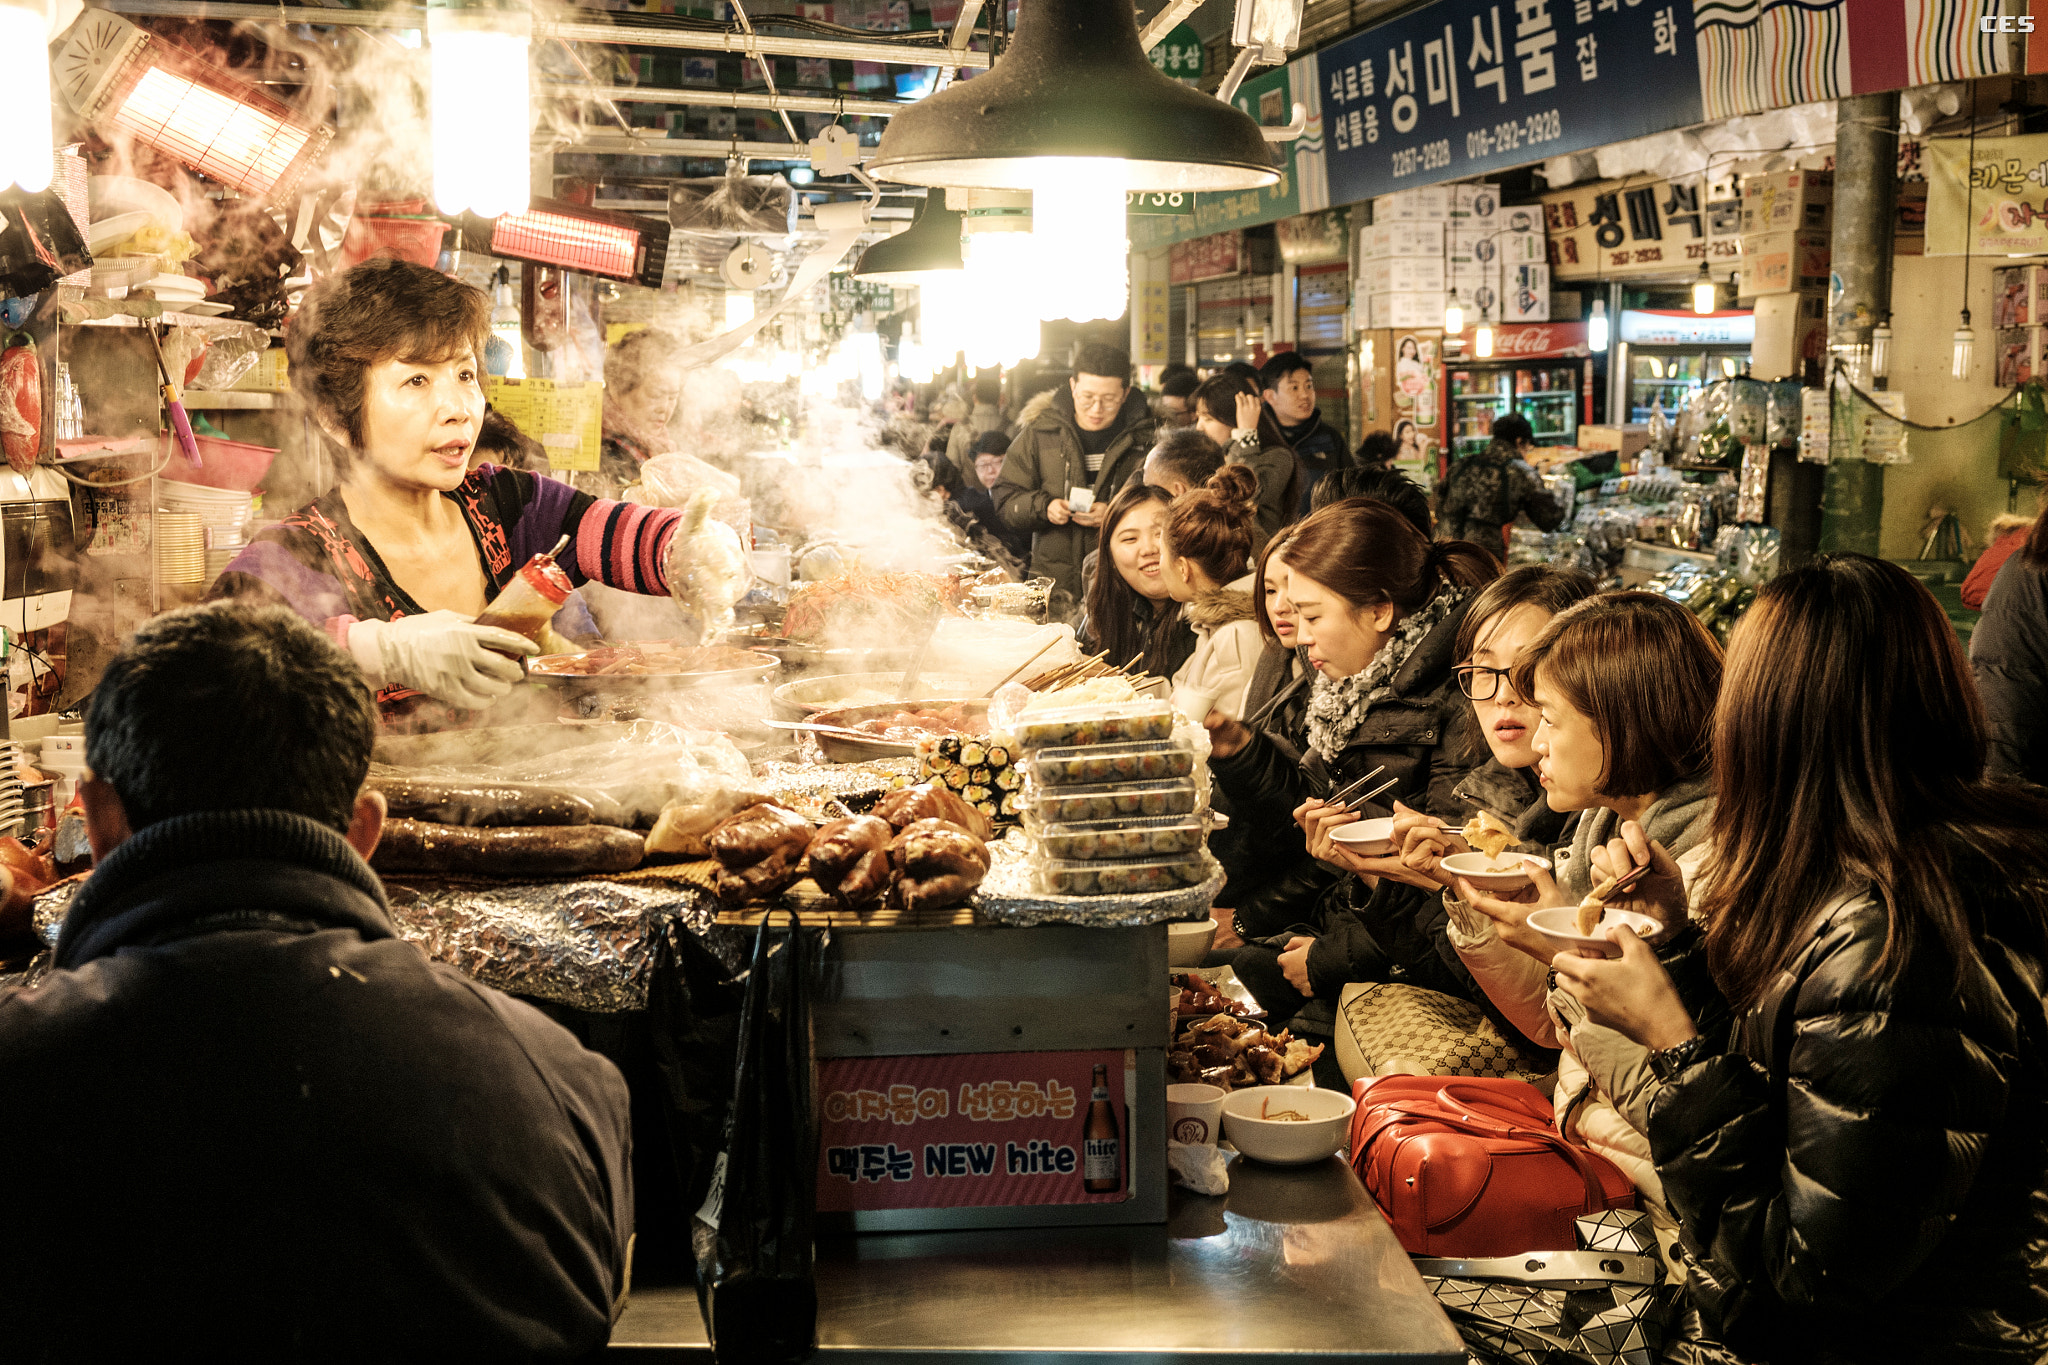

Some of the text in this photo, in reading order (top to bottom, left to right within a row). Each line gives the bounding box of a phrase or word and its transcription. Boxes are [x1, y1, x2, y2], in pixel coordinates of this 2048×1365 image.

[1384, 0, 1558, 134] 성미식품
[1334, 104, 1380, 151] 선물용
[824, 1079, 1077, 1125] 여자들이 선호하는
[827, 1143, 915, 1183] 맥주는
[924, 1143, 997, 1177] NEW
[1006, 1140, 1077, 1175] hite
[1087, 1140, 1117, 1156] hite
